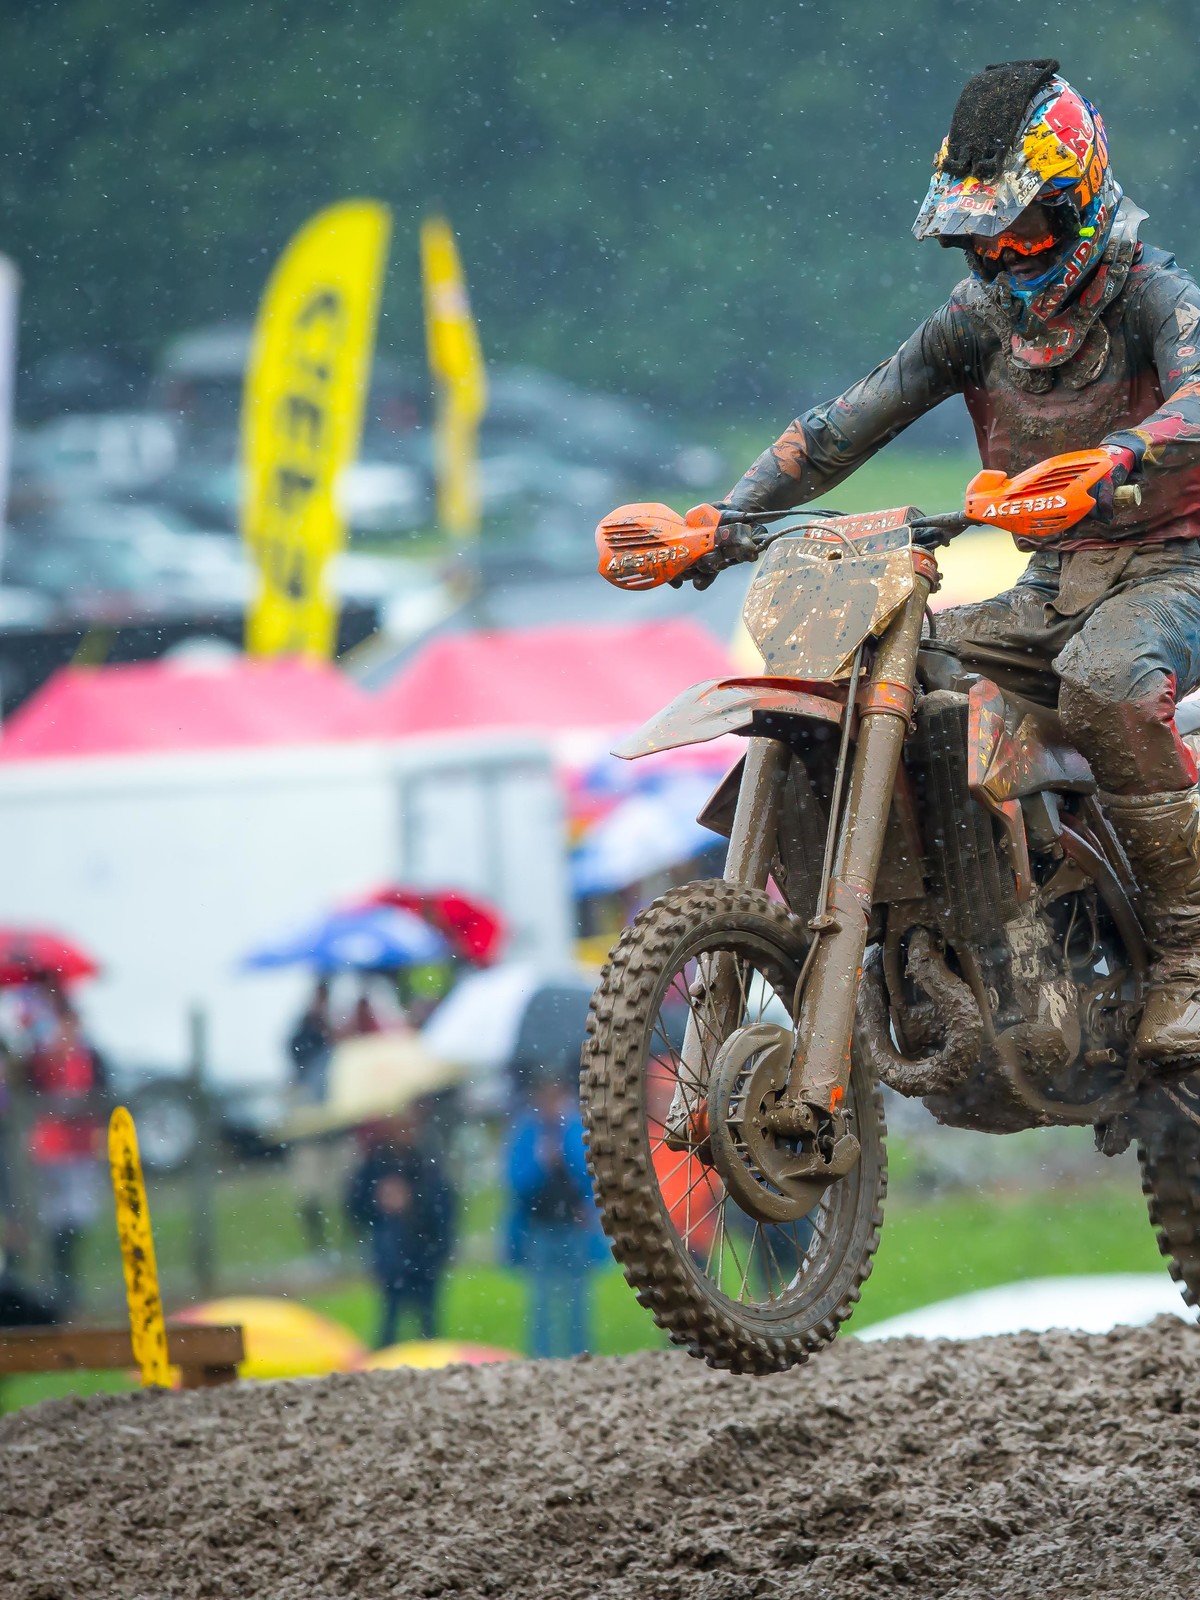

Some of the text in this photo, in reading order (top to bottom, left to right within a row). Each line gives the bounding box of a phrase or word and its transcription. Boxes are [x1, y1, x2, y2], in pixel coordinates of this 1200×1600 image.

[960, 196, 996, 212] Bull
[982, 495, 1068, 518] ACERBIS
[607, 545, 690, 571] ACERBIS
